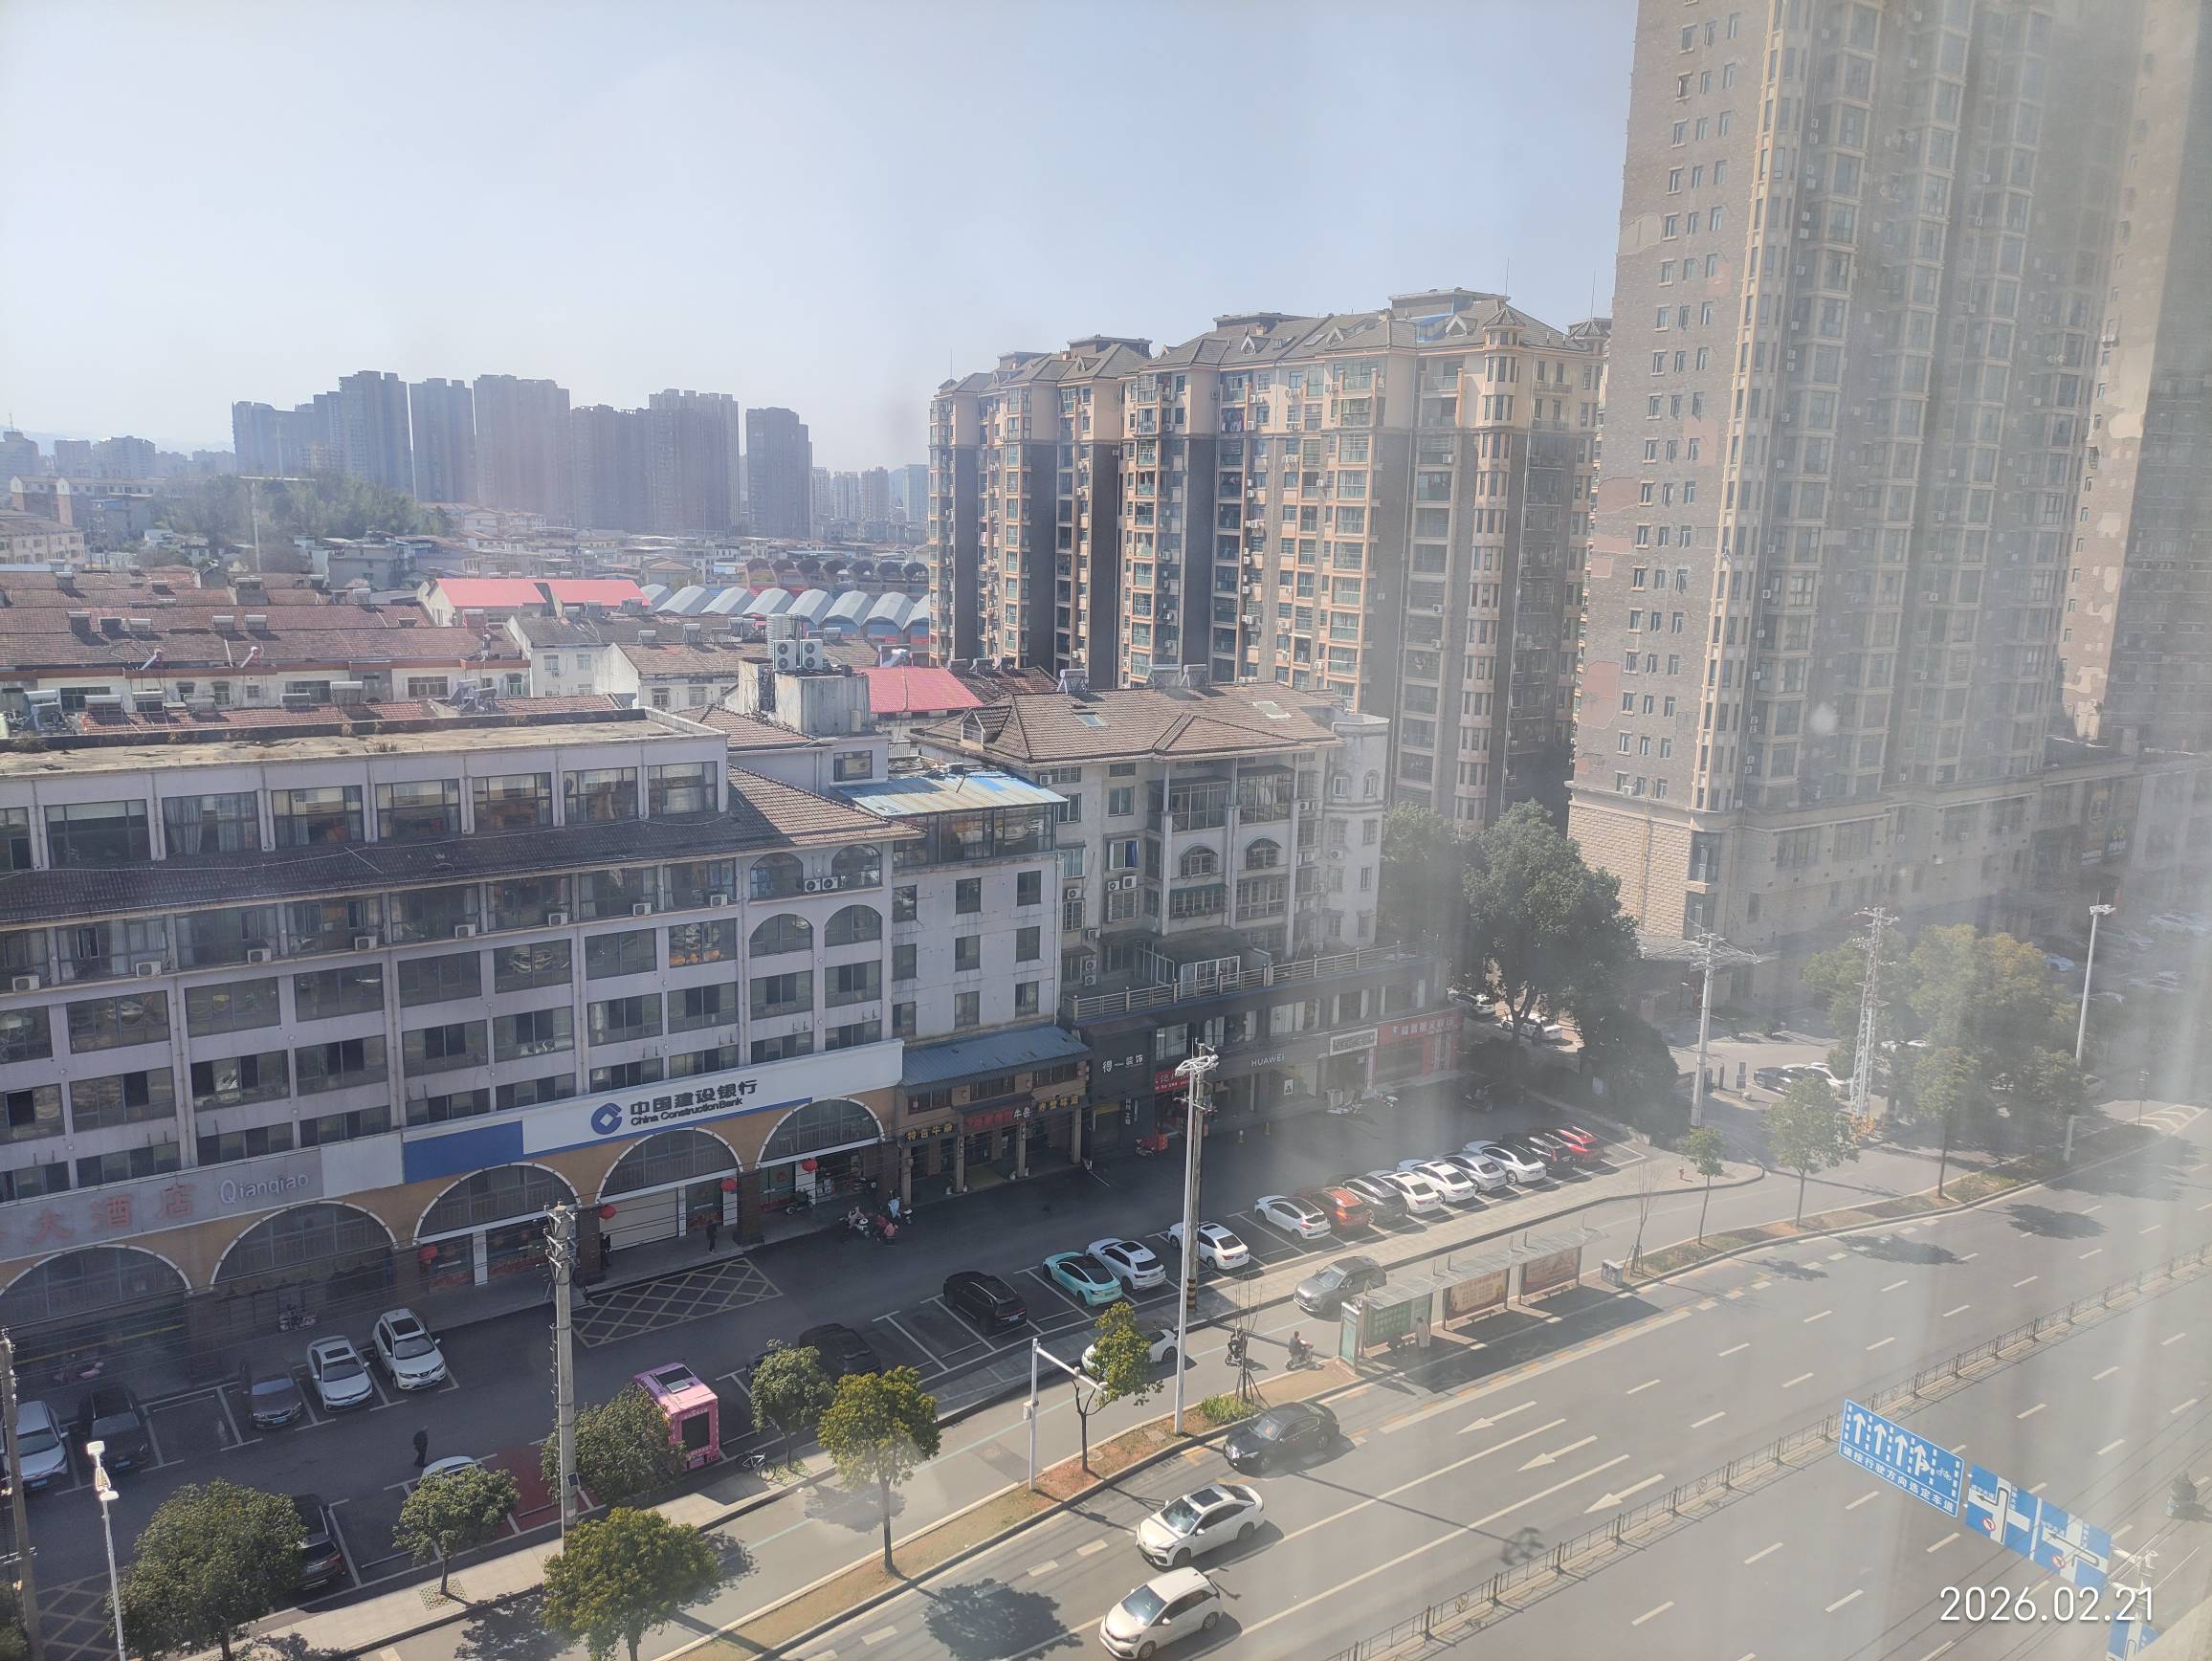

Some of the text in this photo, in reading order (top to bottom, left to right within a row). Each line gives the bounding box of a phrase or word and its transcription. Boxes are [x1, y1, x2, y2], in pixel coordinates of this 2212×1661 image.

[1250, 1053, 1285, 1068] HUAWEI
[630, 1079, 758, 1116] 中国建设银行
[630, 1097, 743, 1126] China Construction Bank
[220, 1174, 308, 1204] Qianqiao
[0, 1183, 197, 1246] 大酒店
[1843, 1445, 1955, 1512] 请按行驶方向选定车道
